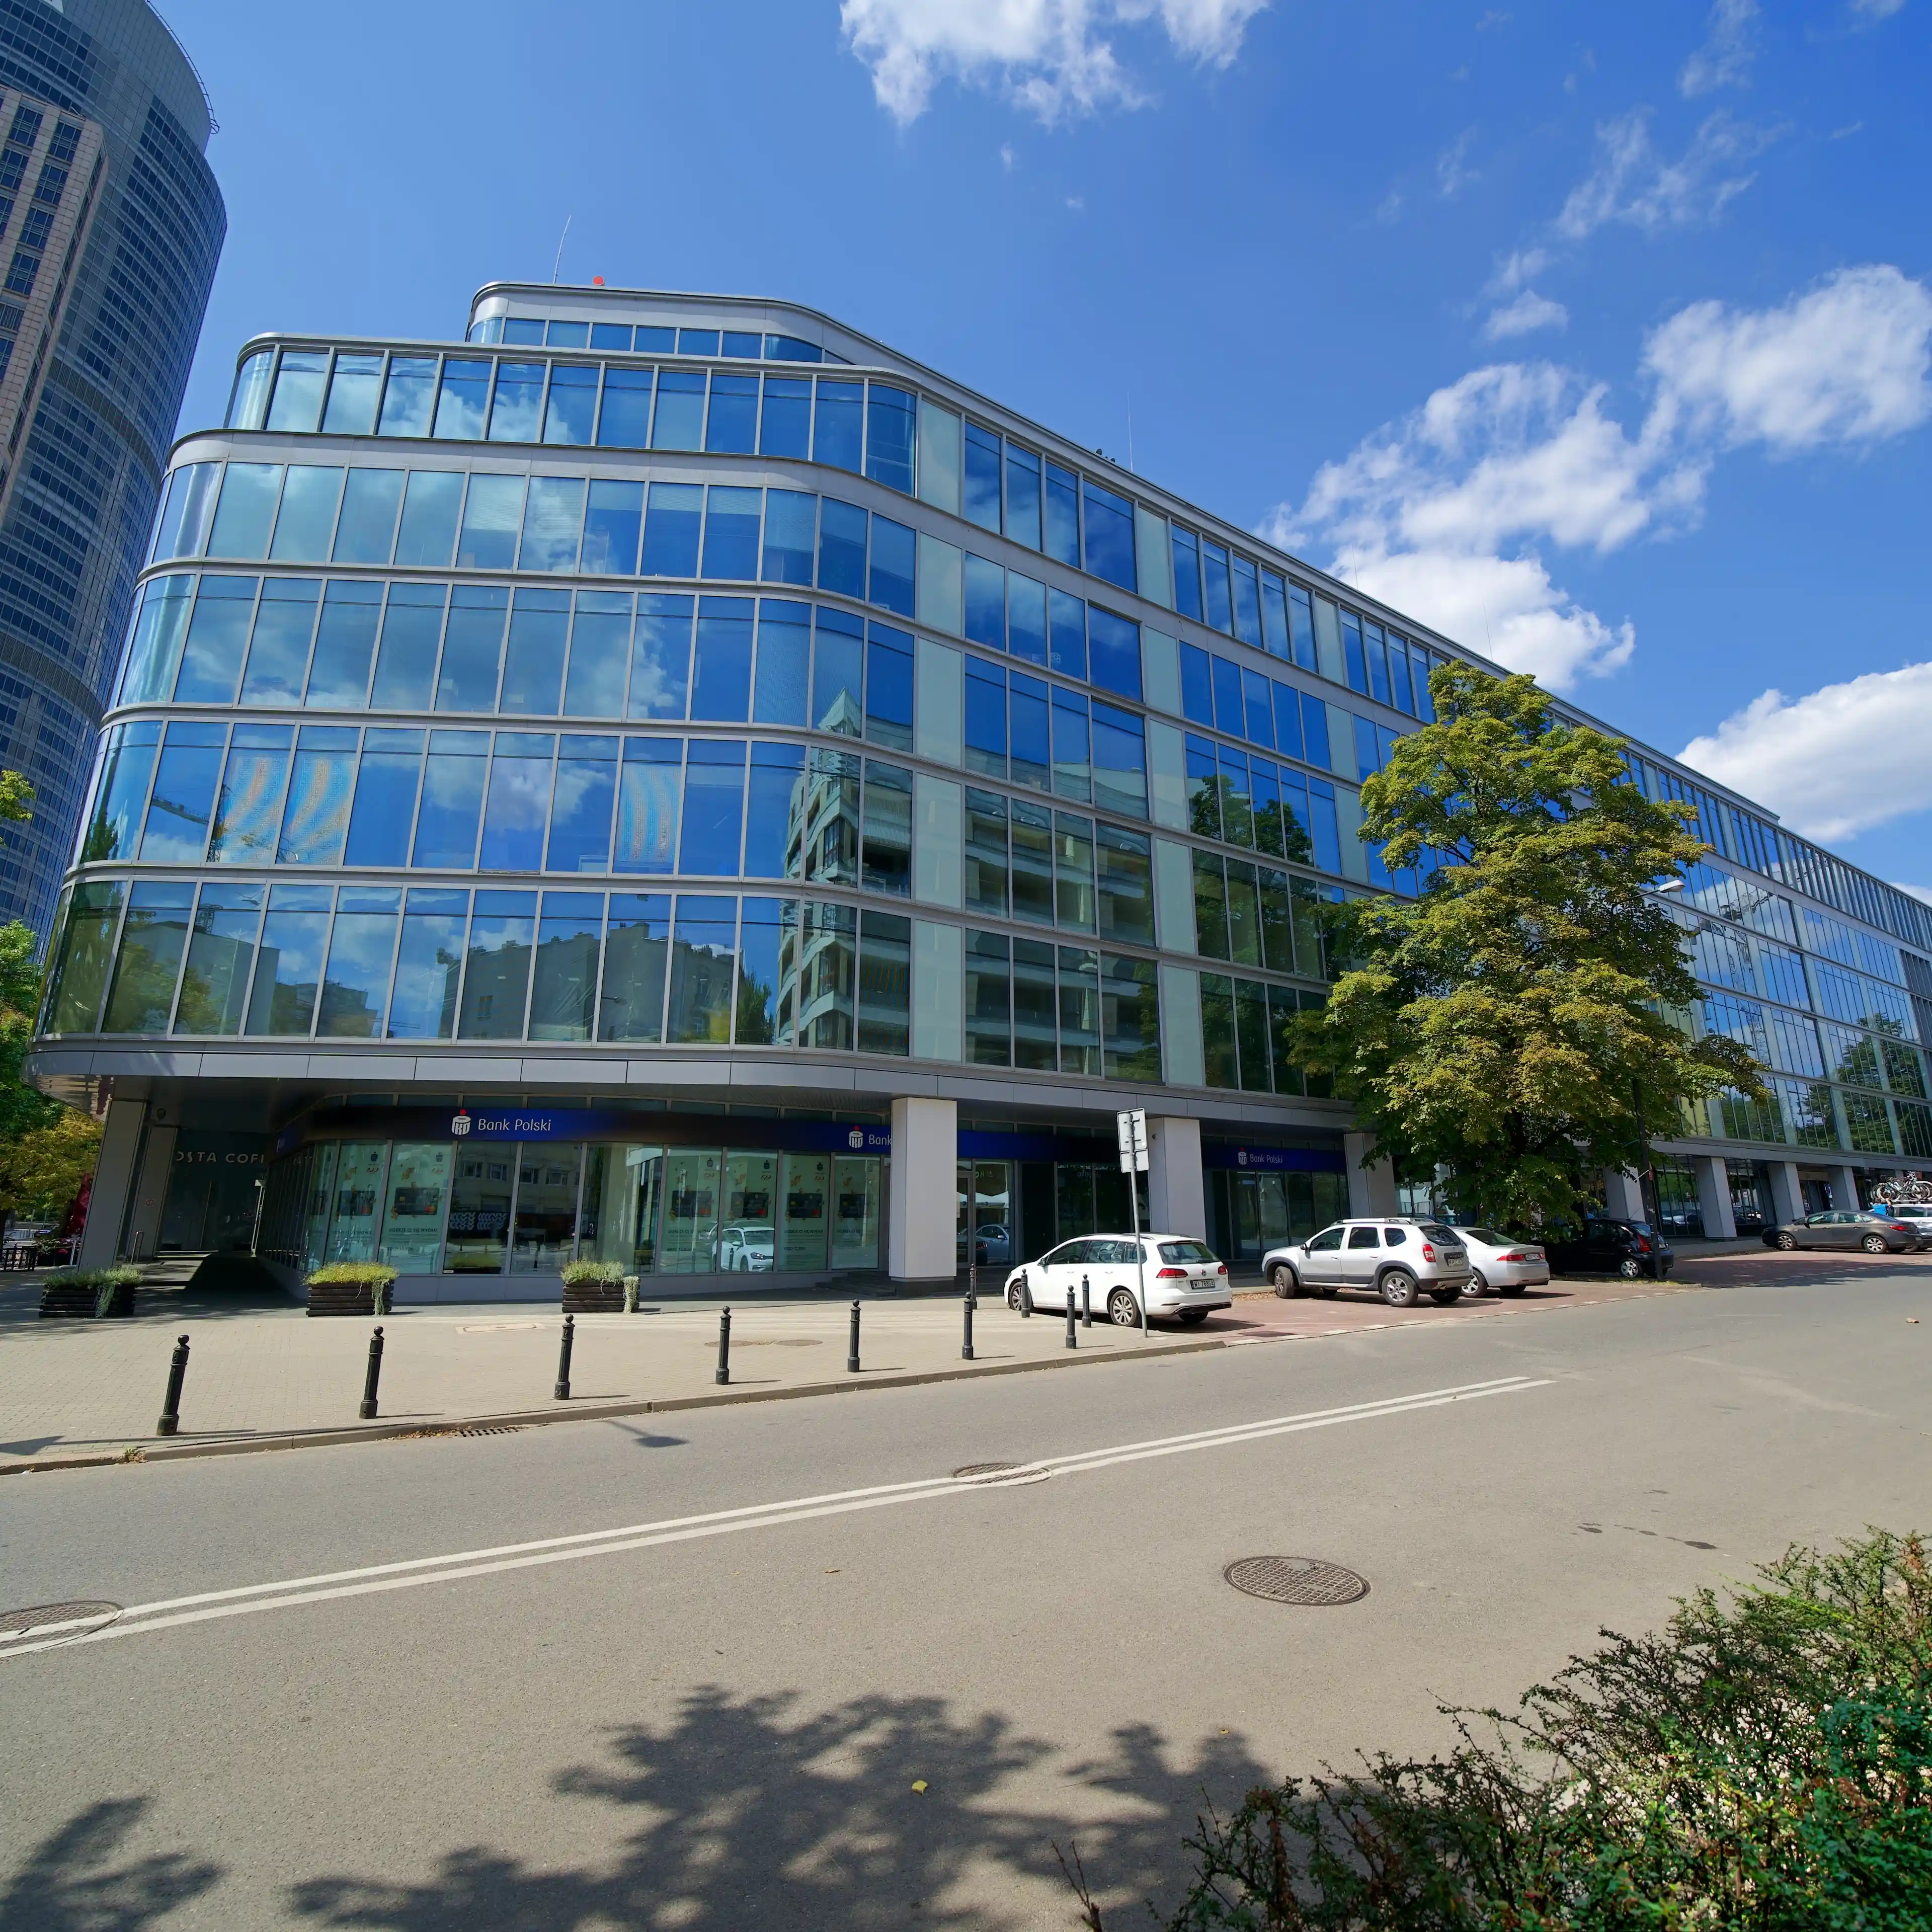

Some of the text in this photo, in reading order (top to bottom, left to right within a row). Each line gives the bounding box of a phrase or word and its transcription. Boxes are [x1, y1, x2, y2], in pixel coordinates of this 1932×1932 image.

[478, 1118, 510, 1131] Bank
[515, 1119, 551, 1131] Polski
[869, 1134, 892, 1145] Bank
[1250, 1154, 1265, 1163] Bank
[1266, 1154, 1283, 1163] Polski
